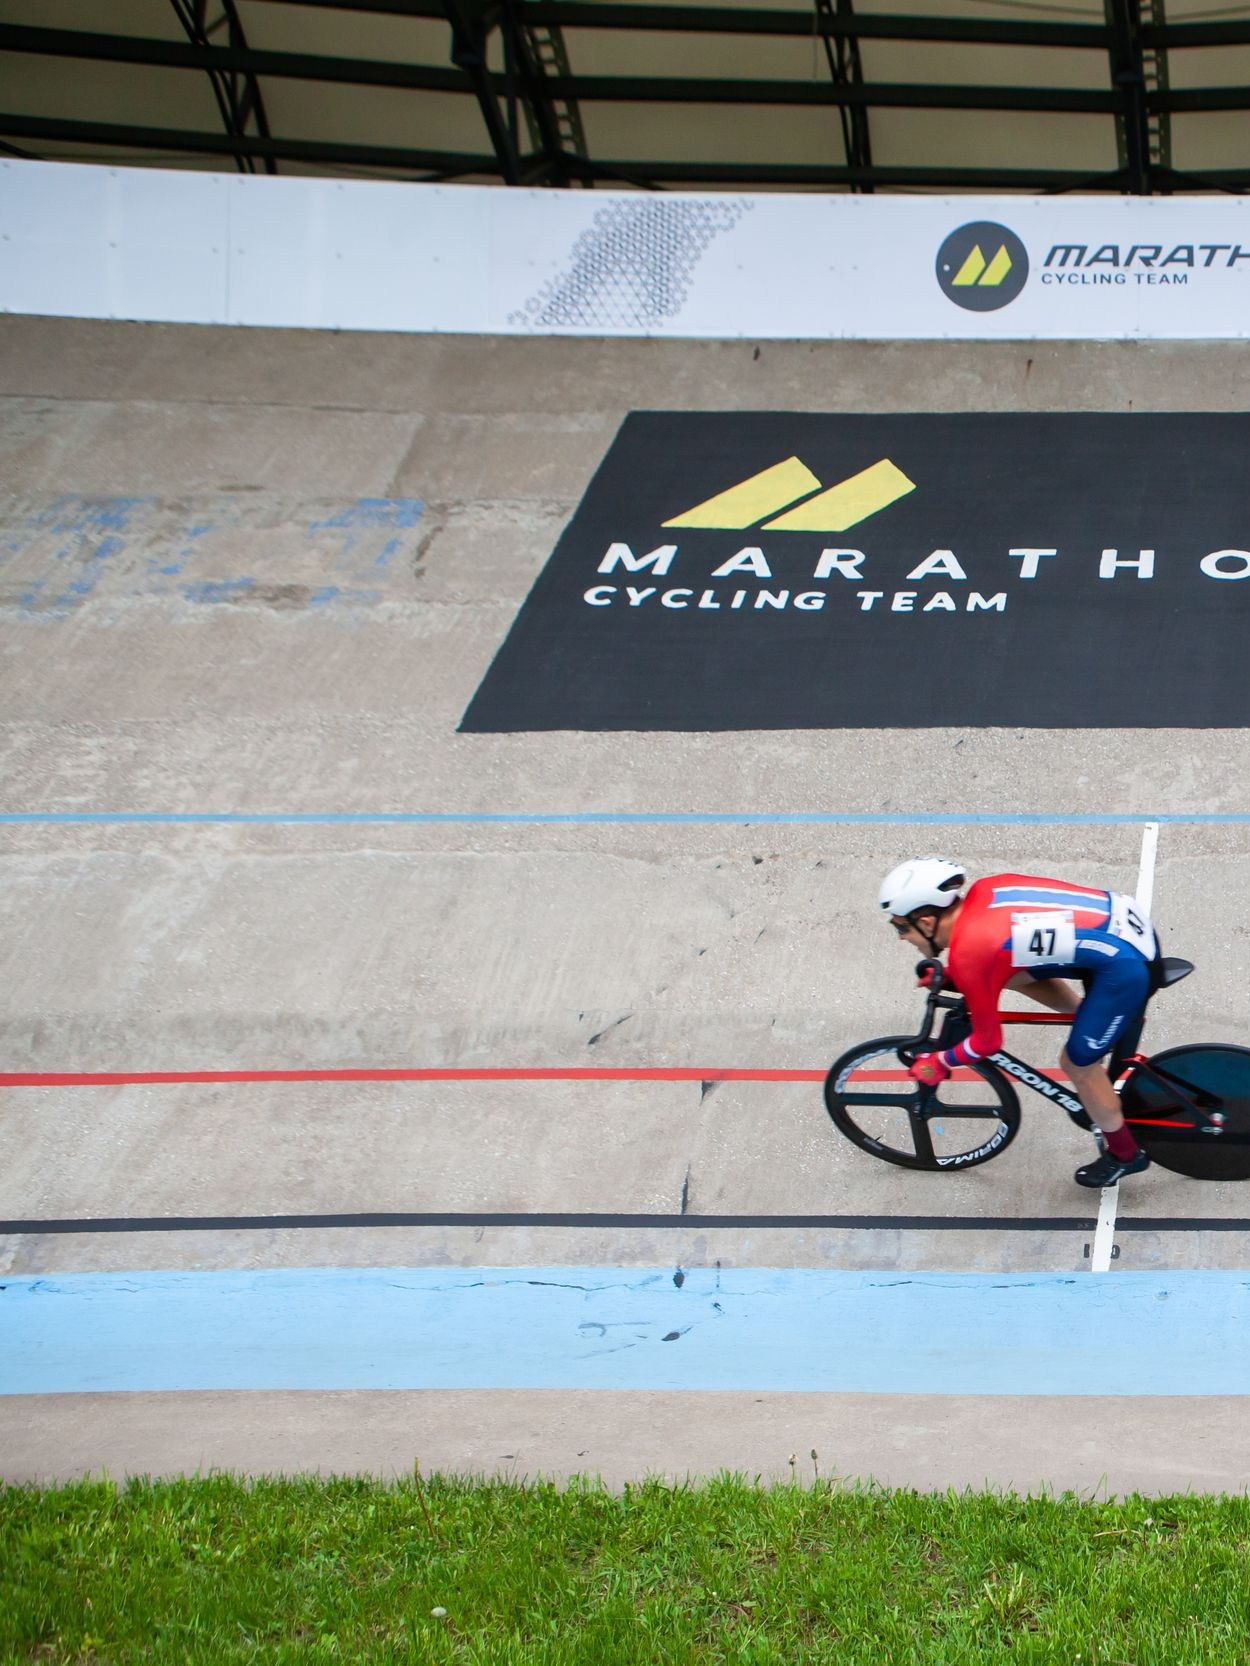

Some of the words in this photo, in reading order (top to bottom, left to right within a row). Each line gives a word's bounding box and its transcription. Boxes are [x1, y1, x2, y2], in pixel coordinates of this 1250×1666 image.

[1041, 272, 1127, 286] CYCLING
[1135, 272, 1188, 286] TEAM
[583, 585, 828, 611] CYCLING
[856, 590, 1008, 612] TEAM
[1028, 929, 1056, 957] 47
[987, 1052, 1060, 1096] RGON
[1057, 1093, 1084, 1113] 18
